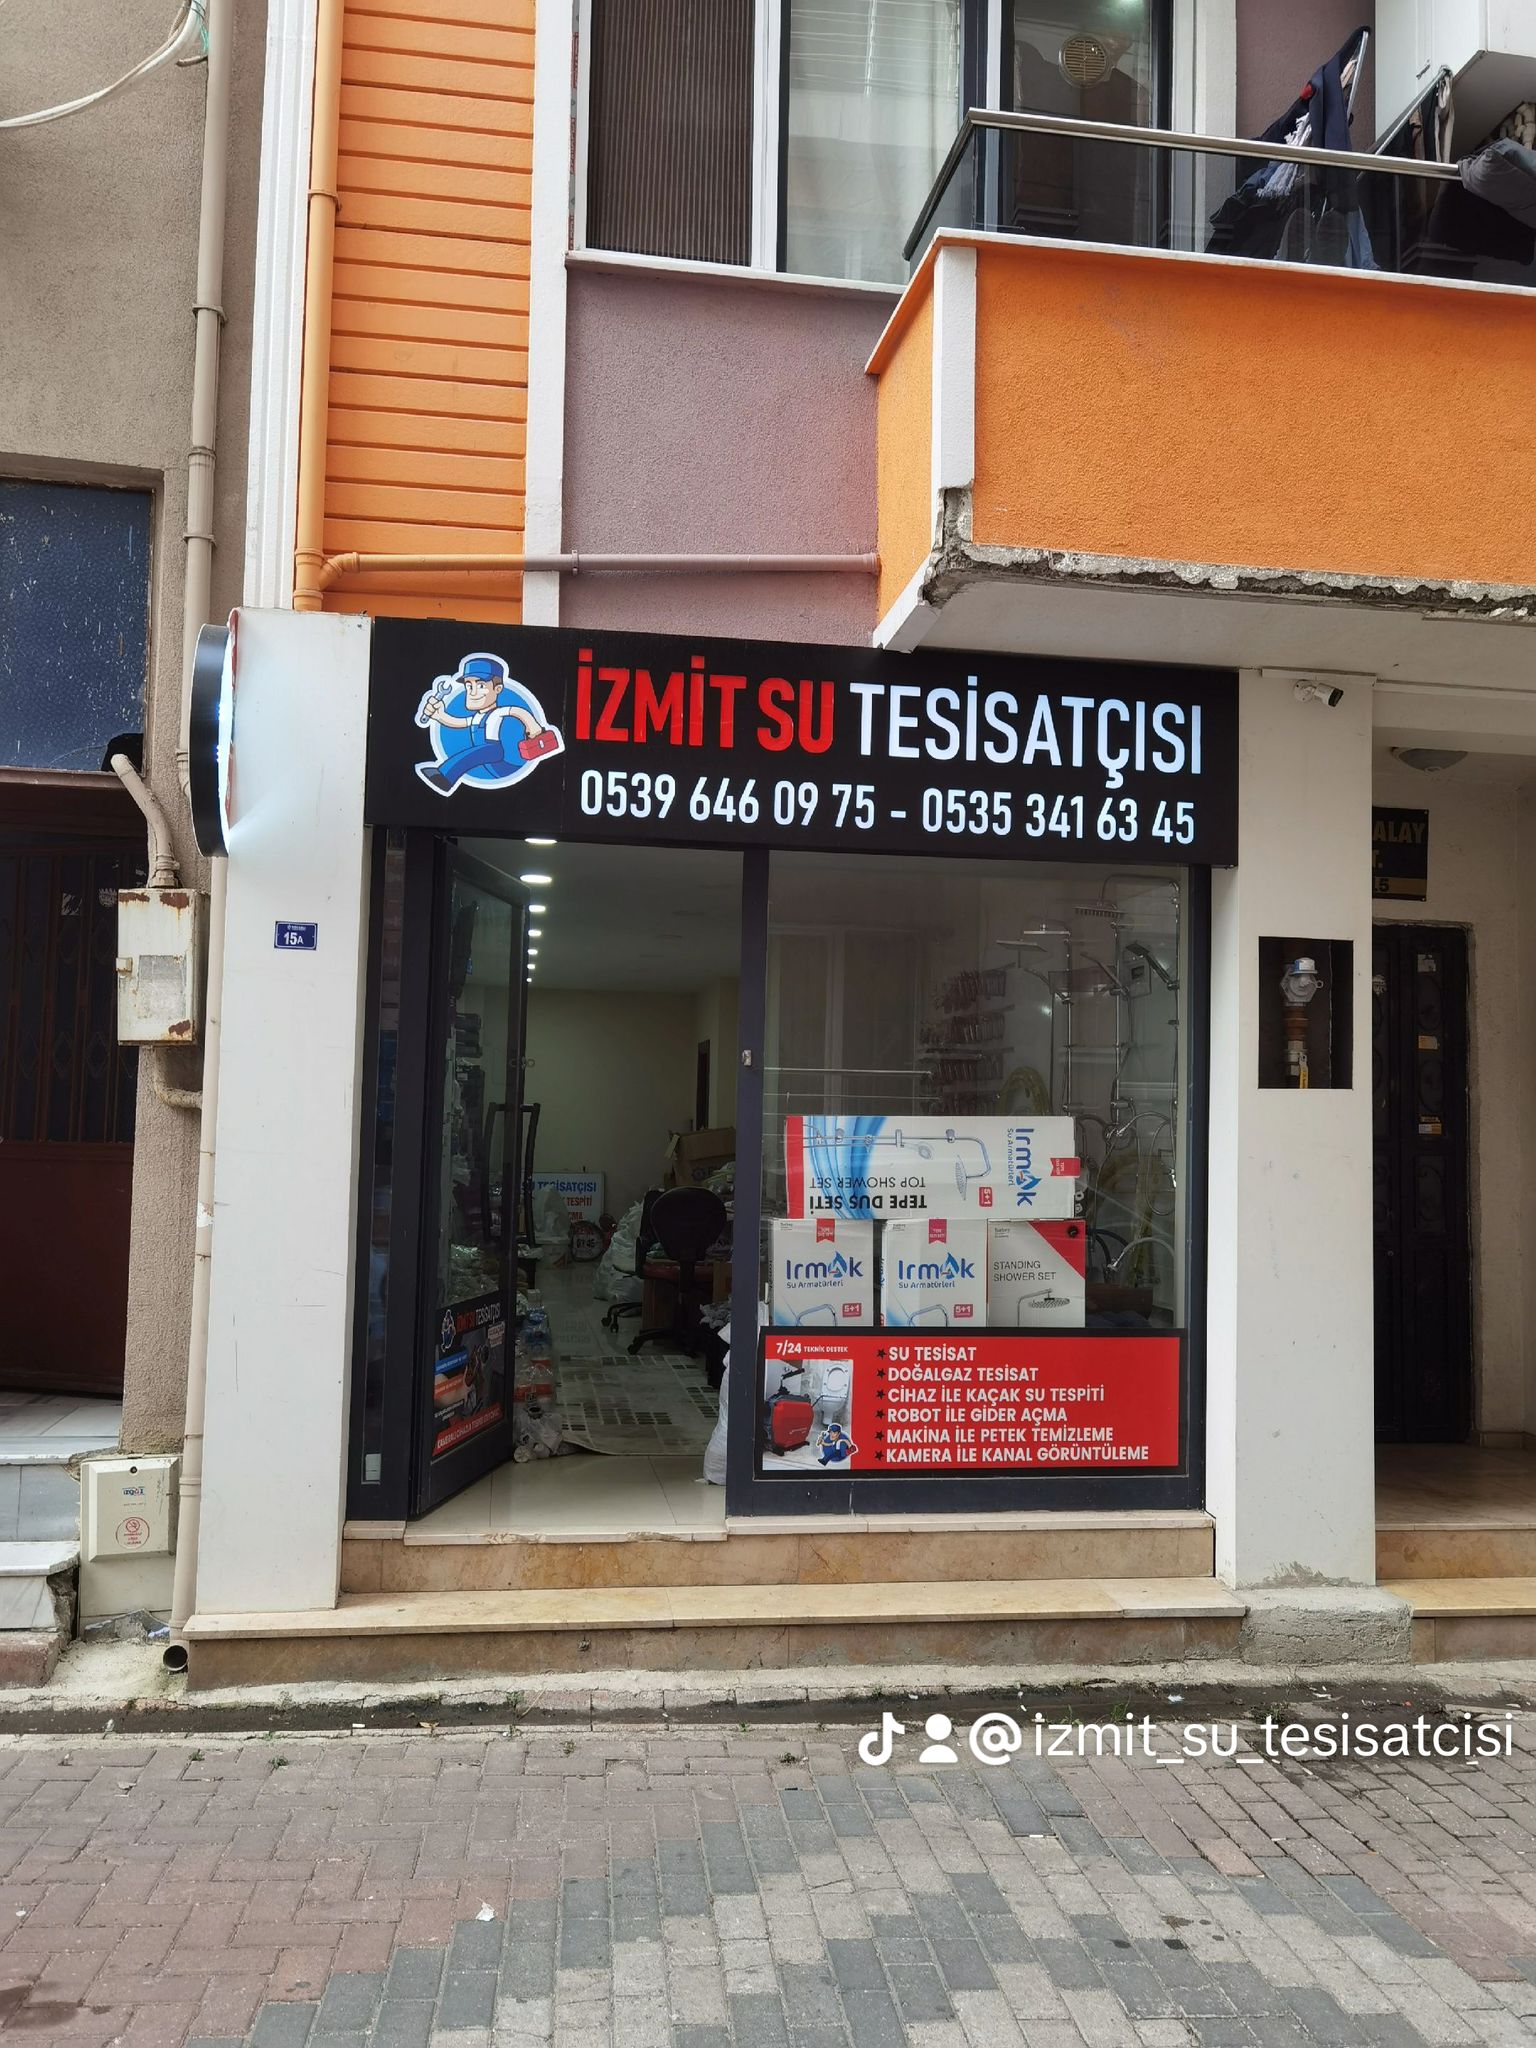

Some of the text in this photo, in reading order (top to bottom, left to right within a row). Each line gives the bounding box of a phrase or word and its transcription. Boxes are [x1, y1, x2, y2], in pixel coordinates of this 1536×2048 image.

[576, 648, 1202, 789] İZMİT SU TESİSATÇISI
[580, 769, 676, 818] 0539
[689, 776, 759, 824] 646
[772, 779, 819, 827] 09
[831, 782, 874, 830] 75
[922, 787, 1012, 837] 0535
[1024, 793, 1084, 840] 341
[1095, 798, 1138, 844] 63
[1150, 801, 1195, 847] 45
[284, 932, 304, 945] 15A
[810, 1176, 926, 1188] TOP SHOWER SET
[810, 1192, 927, 1214] TEPE DUŞ SETİ
[994, 1260, 1041, 1270] STANDING
[994, 1272, 1056, 1282] SHOWER SET
[844, 1304, 860, 1312] 5+1
[776, 1341, 802, 1356] 7/24
[804, 1344, 826, 1353] TEKNİK
[888, 1344, 976, 1361] SU TESİSAT
[888, 1364, 1039, 1382] DOĞALGAZ TESİSAT
[888, 1384, 1105, 1407] CİHAZ İLE KAÇAK SU TESPİTİ
[888, 1406, 1068, 1426] ROBOT İLE GİDER AÇMA
[886, 1425, 1114, 1444] MAKİNA İLE PETEK TEMİZLEME
[886, 1444, 1149, 1464] KAMERA İLE KANAL GÖRÜNTÜLEME
